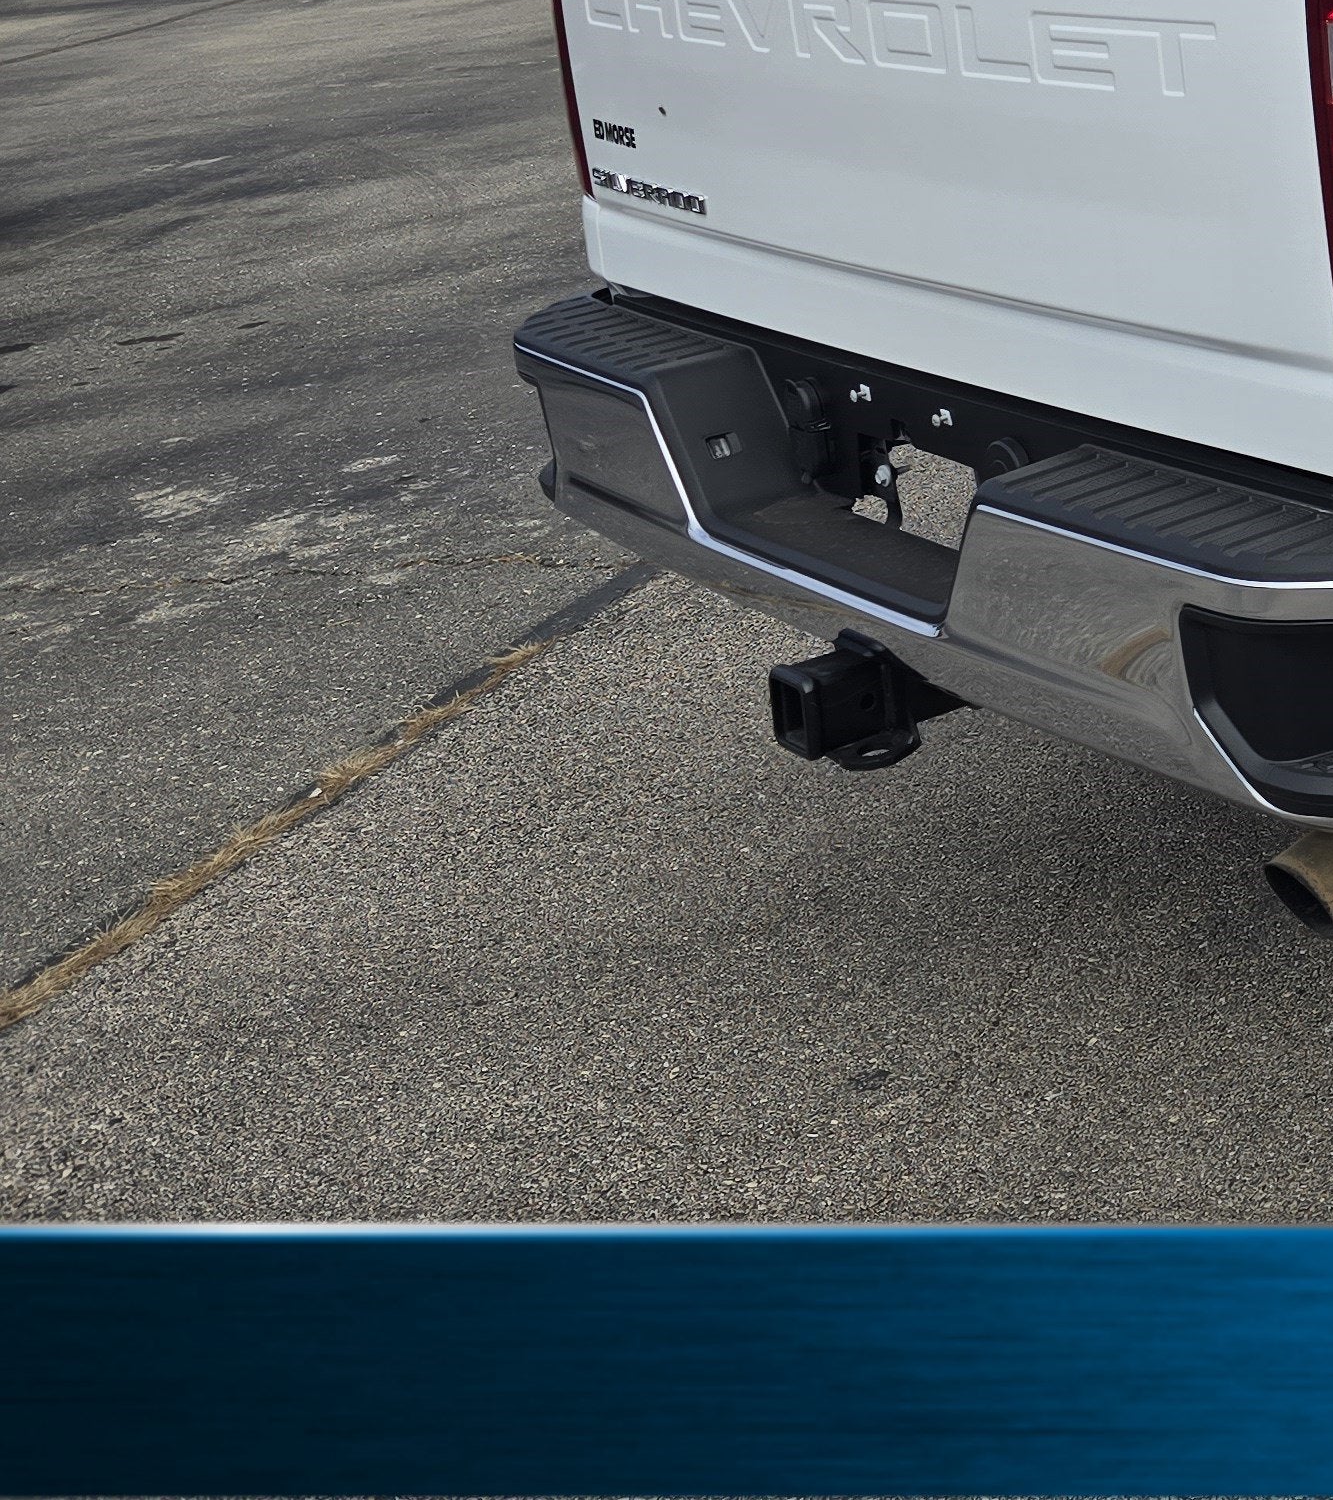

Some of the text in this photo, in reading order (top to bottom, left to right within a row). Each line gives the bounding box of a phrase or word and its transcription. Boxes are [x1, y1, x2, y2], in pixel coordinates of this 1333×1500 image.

[593, 118, 637, 149] ED MORSE
[592, 166, 708, 216] SILVERADO
